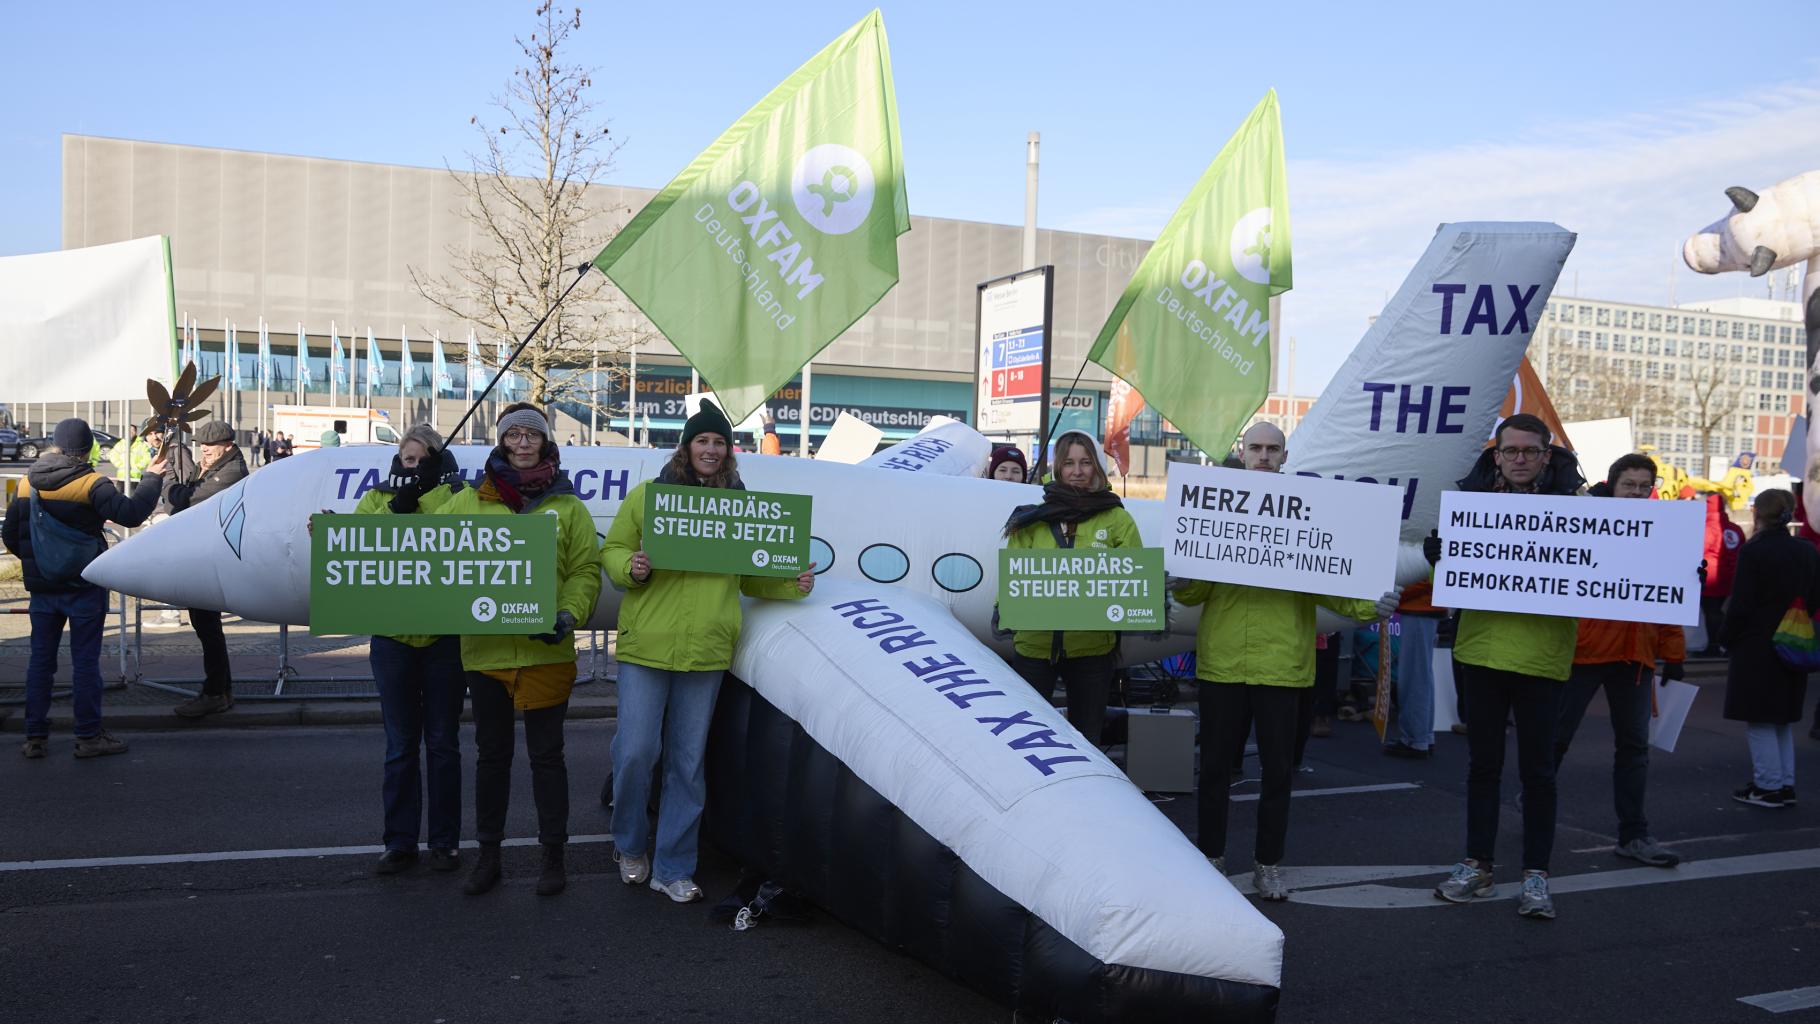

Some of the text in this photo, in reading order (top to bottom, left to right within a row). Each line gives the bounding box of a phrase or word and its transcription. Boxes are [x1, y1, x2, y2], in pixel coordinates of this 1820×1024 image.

[727, 180, 825, 301] OXFAM
[694, 203, 797, 331] Deutschland
[1180, 259, 1270, 347] OXFAM
[1432, 283, 1541, 336] TAX
[1156, 287, 1255, 376] Deutschland
[997, 373, 1005, 392] 9
[1062, 396, 1092, 407] CDU
[1363, 382, 1471, 434] THE
[851, 408, 961, 425] Deutschlas
[900, 437, 954, 463] RICH
[335, 468, 380, 500] TA
[655, 493, 791, 520] MILLIARDÄRS-
[1180, 484, 1251, 514] MERZ
[1257, 493, 1311, 521] AIR:
[327, 521, 526, 552] MILLIARDÄRS-
[653, 517, 794, 544] STEUER JETZT!
[1176, 516, 1333, 550] STEUERFREI FÜR
[1450, 511, 1653, 538] MILLIARDÄRSMACHT
[772, 554, 798, 564] OXFAM
[1009, 553, 1144, 575] MILLIARDÄRS-
[1448, 540, 1598, 569] BESCHRÄNKEN,
[326, 560, 532, 585] STEUER JETZT!
[1008, 579, 1148, 598] STEUER JETZT!
[1445, 571, 1684, 605] DEMOKRATIE SCHÜTZEN
[501, 603, 539, 614] OXFAM
[501, 616, 544, 624] Deutschland
[1127, 608, 1153, 617] OXFAM
[831, 598, 1092, 777] TAX THE RICH
